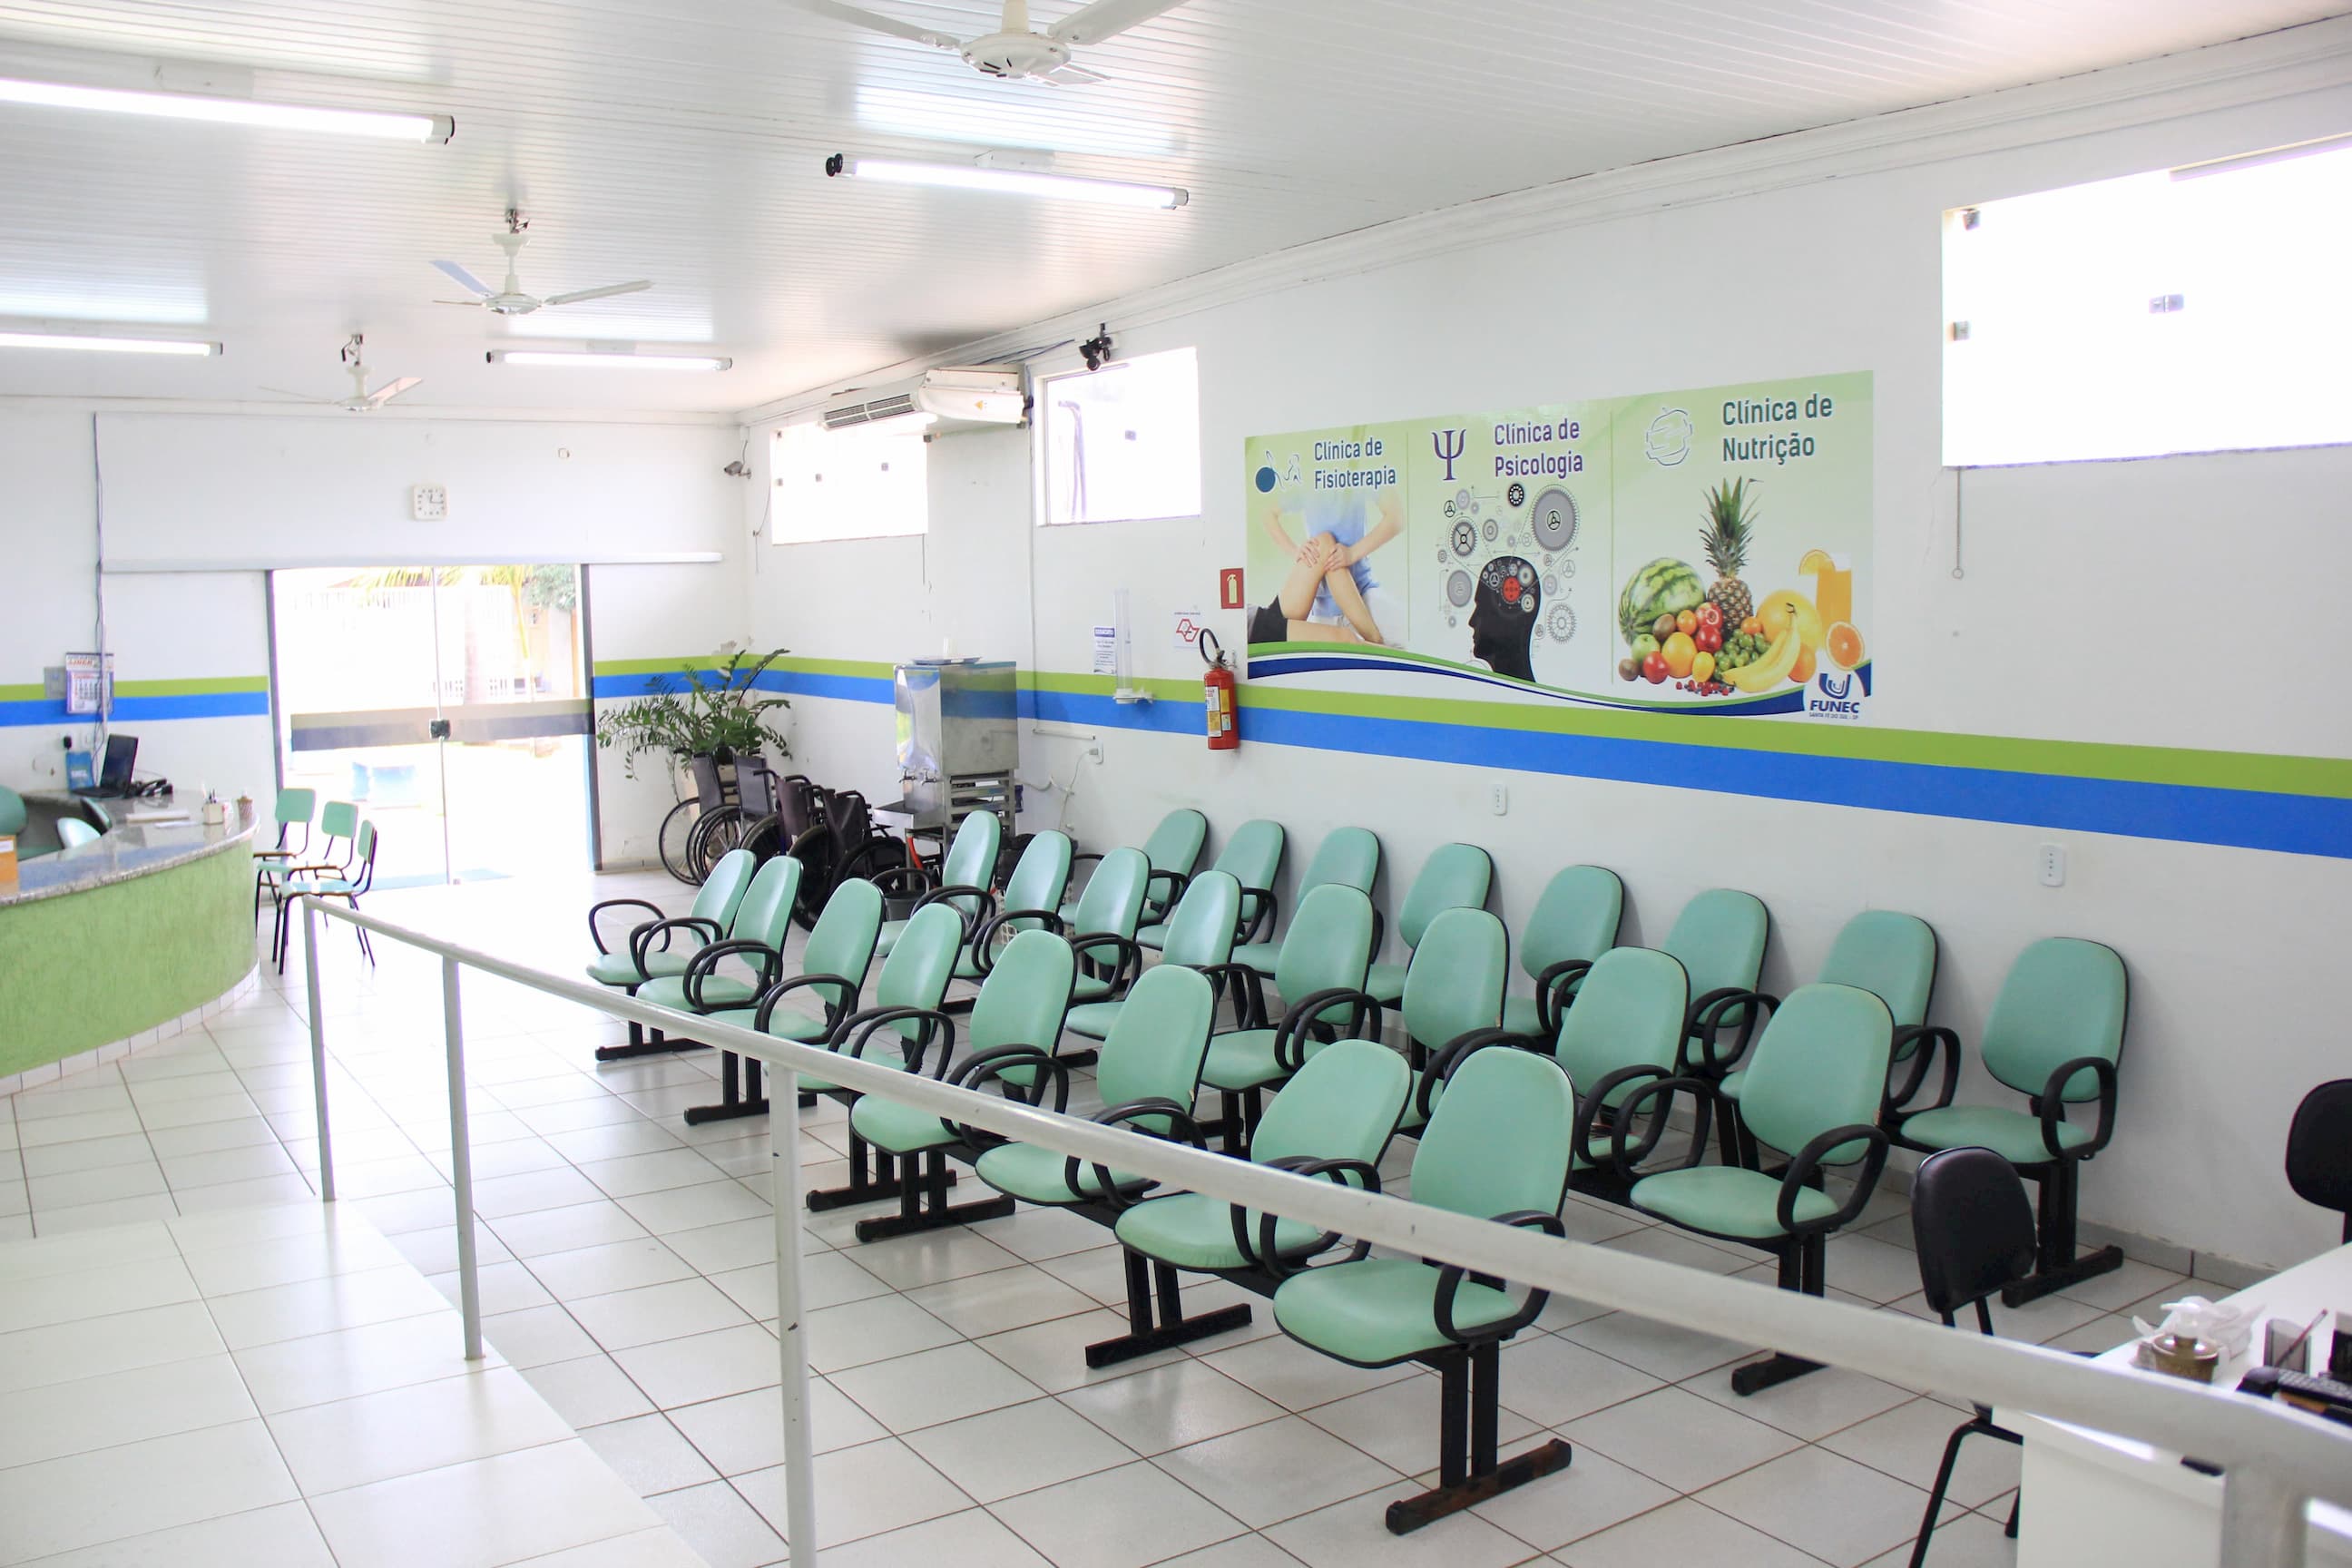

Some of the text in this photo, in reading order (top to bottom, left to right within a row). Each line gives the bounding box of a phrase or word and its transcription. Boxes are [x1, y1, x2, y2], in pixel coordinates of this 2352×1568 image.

[1723, 393, 1832, 426] Clínica de
[1494, 417, 1580, 446] Clínica de
[1315, 436, 1382, 461] Clínica de
[1723, 432, 1815, 466] Nutrição
[1315, 465, 1396, 490] Fisioterapia
[1494, 450, 1583, 479] Psicologia
[1810, 700, 1860, 714] FUNEC
